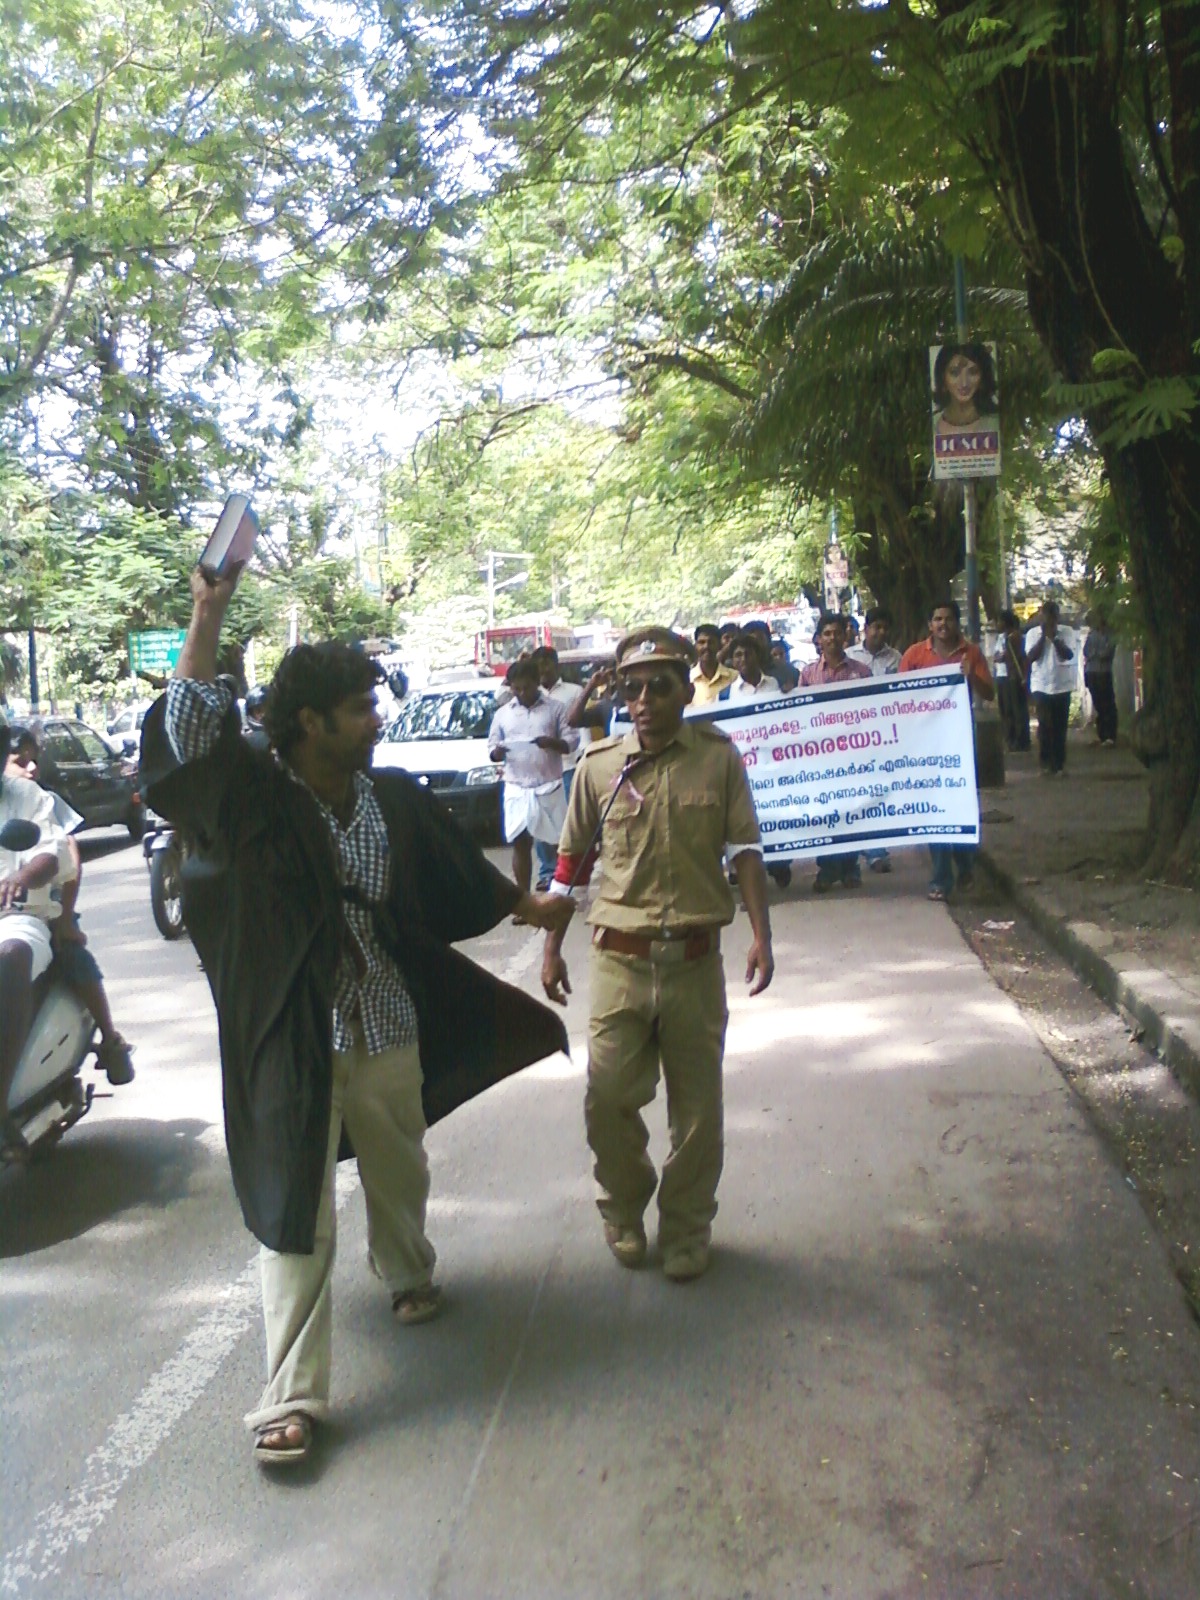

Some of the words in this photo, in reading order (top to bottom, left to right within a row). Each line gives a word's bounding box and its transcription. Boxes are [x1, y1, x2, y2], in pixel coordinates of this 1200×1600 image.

[888, 677, 948, 690] LAWCOS
[754, 695, 814, 712] LAWCOS
[810, 707, 878, 728] നിങ്ങളുടെ
[907, 825, 962, 835] LAWCOS
[774, 837, 833, 851] LAWCOS
